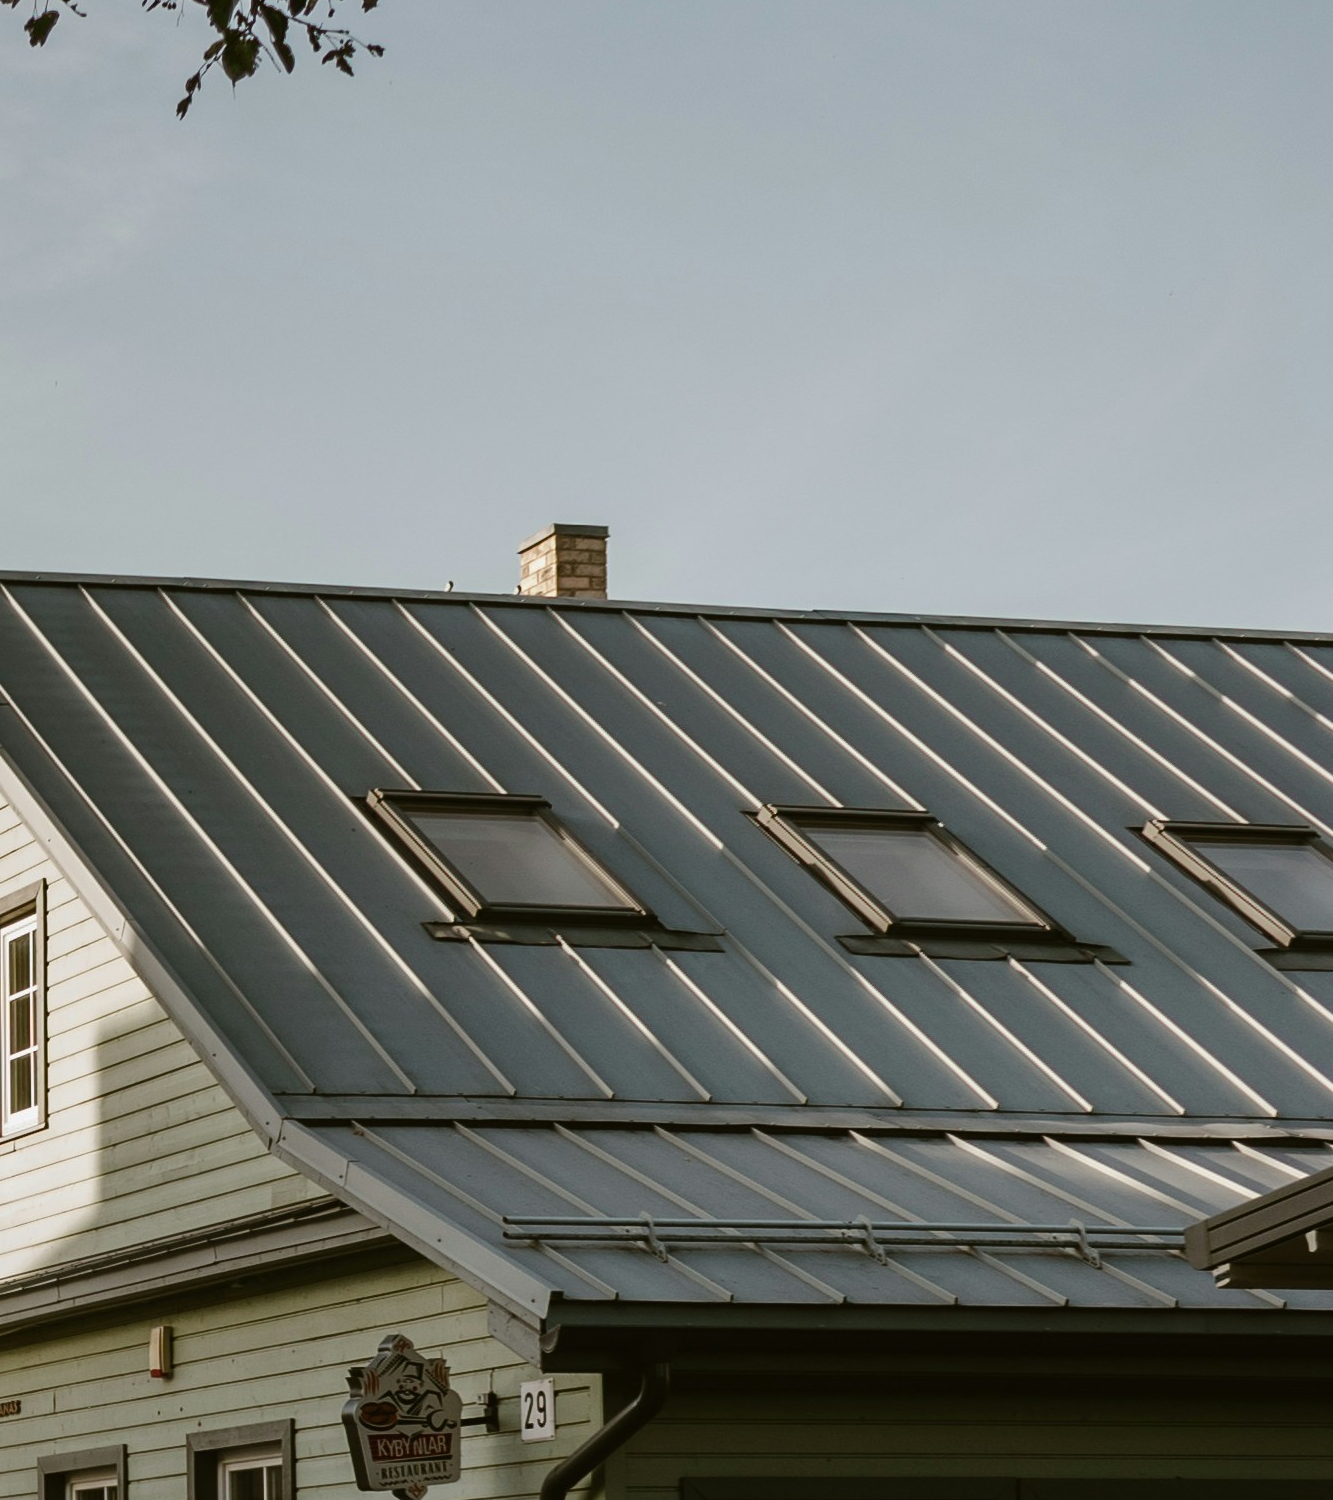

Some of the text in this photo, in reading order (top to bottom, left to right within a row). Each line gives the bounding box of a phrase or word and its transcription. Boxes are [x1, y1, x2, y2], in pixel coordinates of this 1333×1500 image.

[525, 1391, 546, 1429] 29
[377, 1435, 447, 1457] KYBYNLAR
[381, 1461, 447, 1479] RESTAURANT
